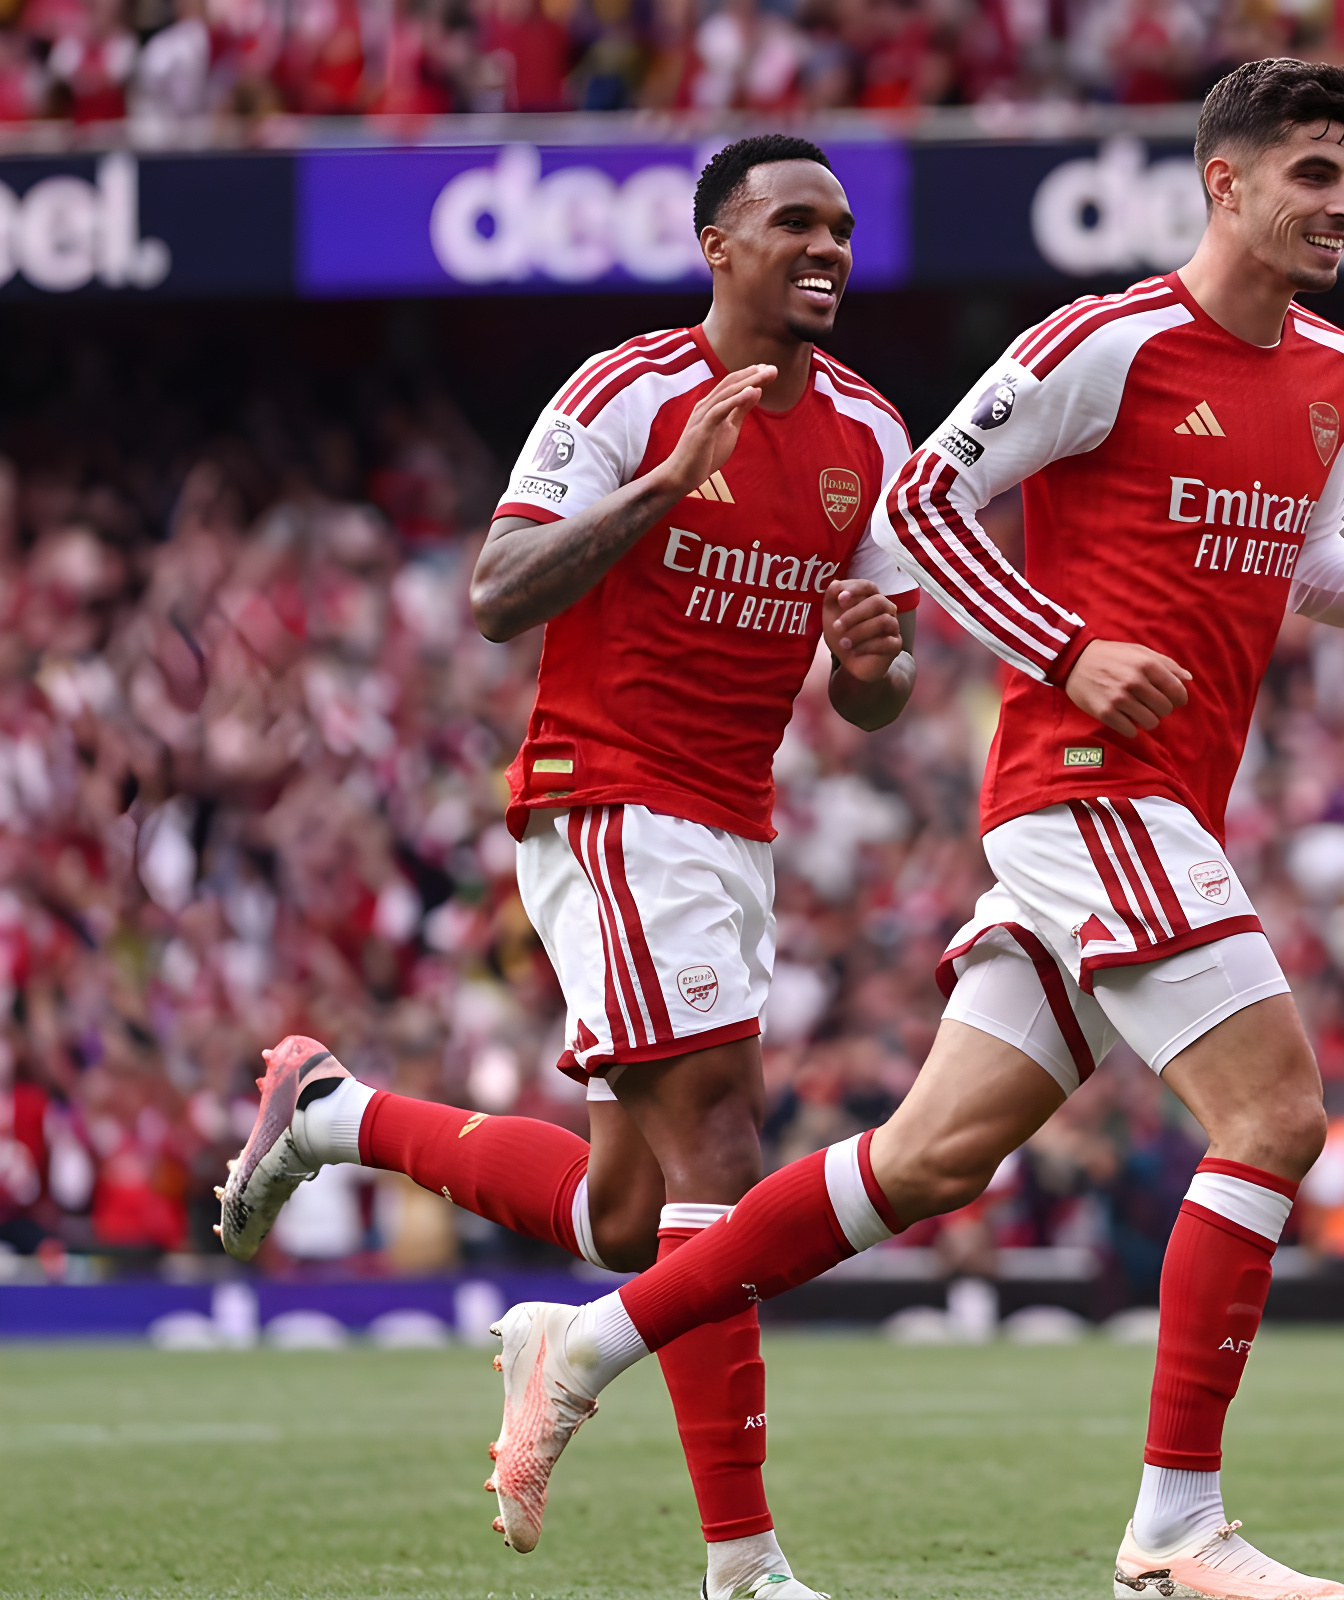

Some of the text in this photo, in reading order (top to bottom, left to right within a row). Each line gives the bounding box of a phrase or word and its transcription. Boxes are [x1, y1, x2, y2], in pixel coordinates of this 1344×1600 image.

[0, 150, 172, 293] el.
[430, 141, 714, 285] dee
[1168, 475, 1319, 534] Emirate
[663, 526, 841, 594] Emirate
[1194, 533, 1299, 579] FLY BETTE
[684, 585, 735, 624] FLY
[1218, 1336, 1253, 1356] AF
